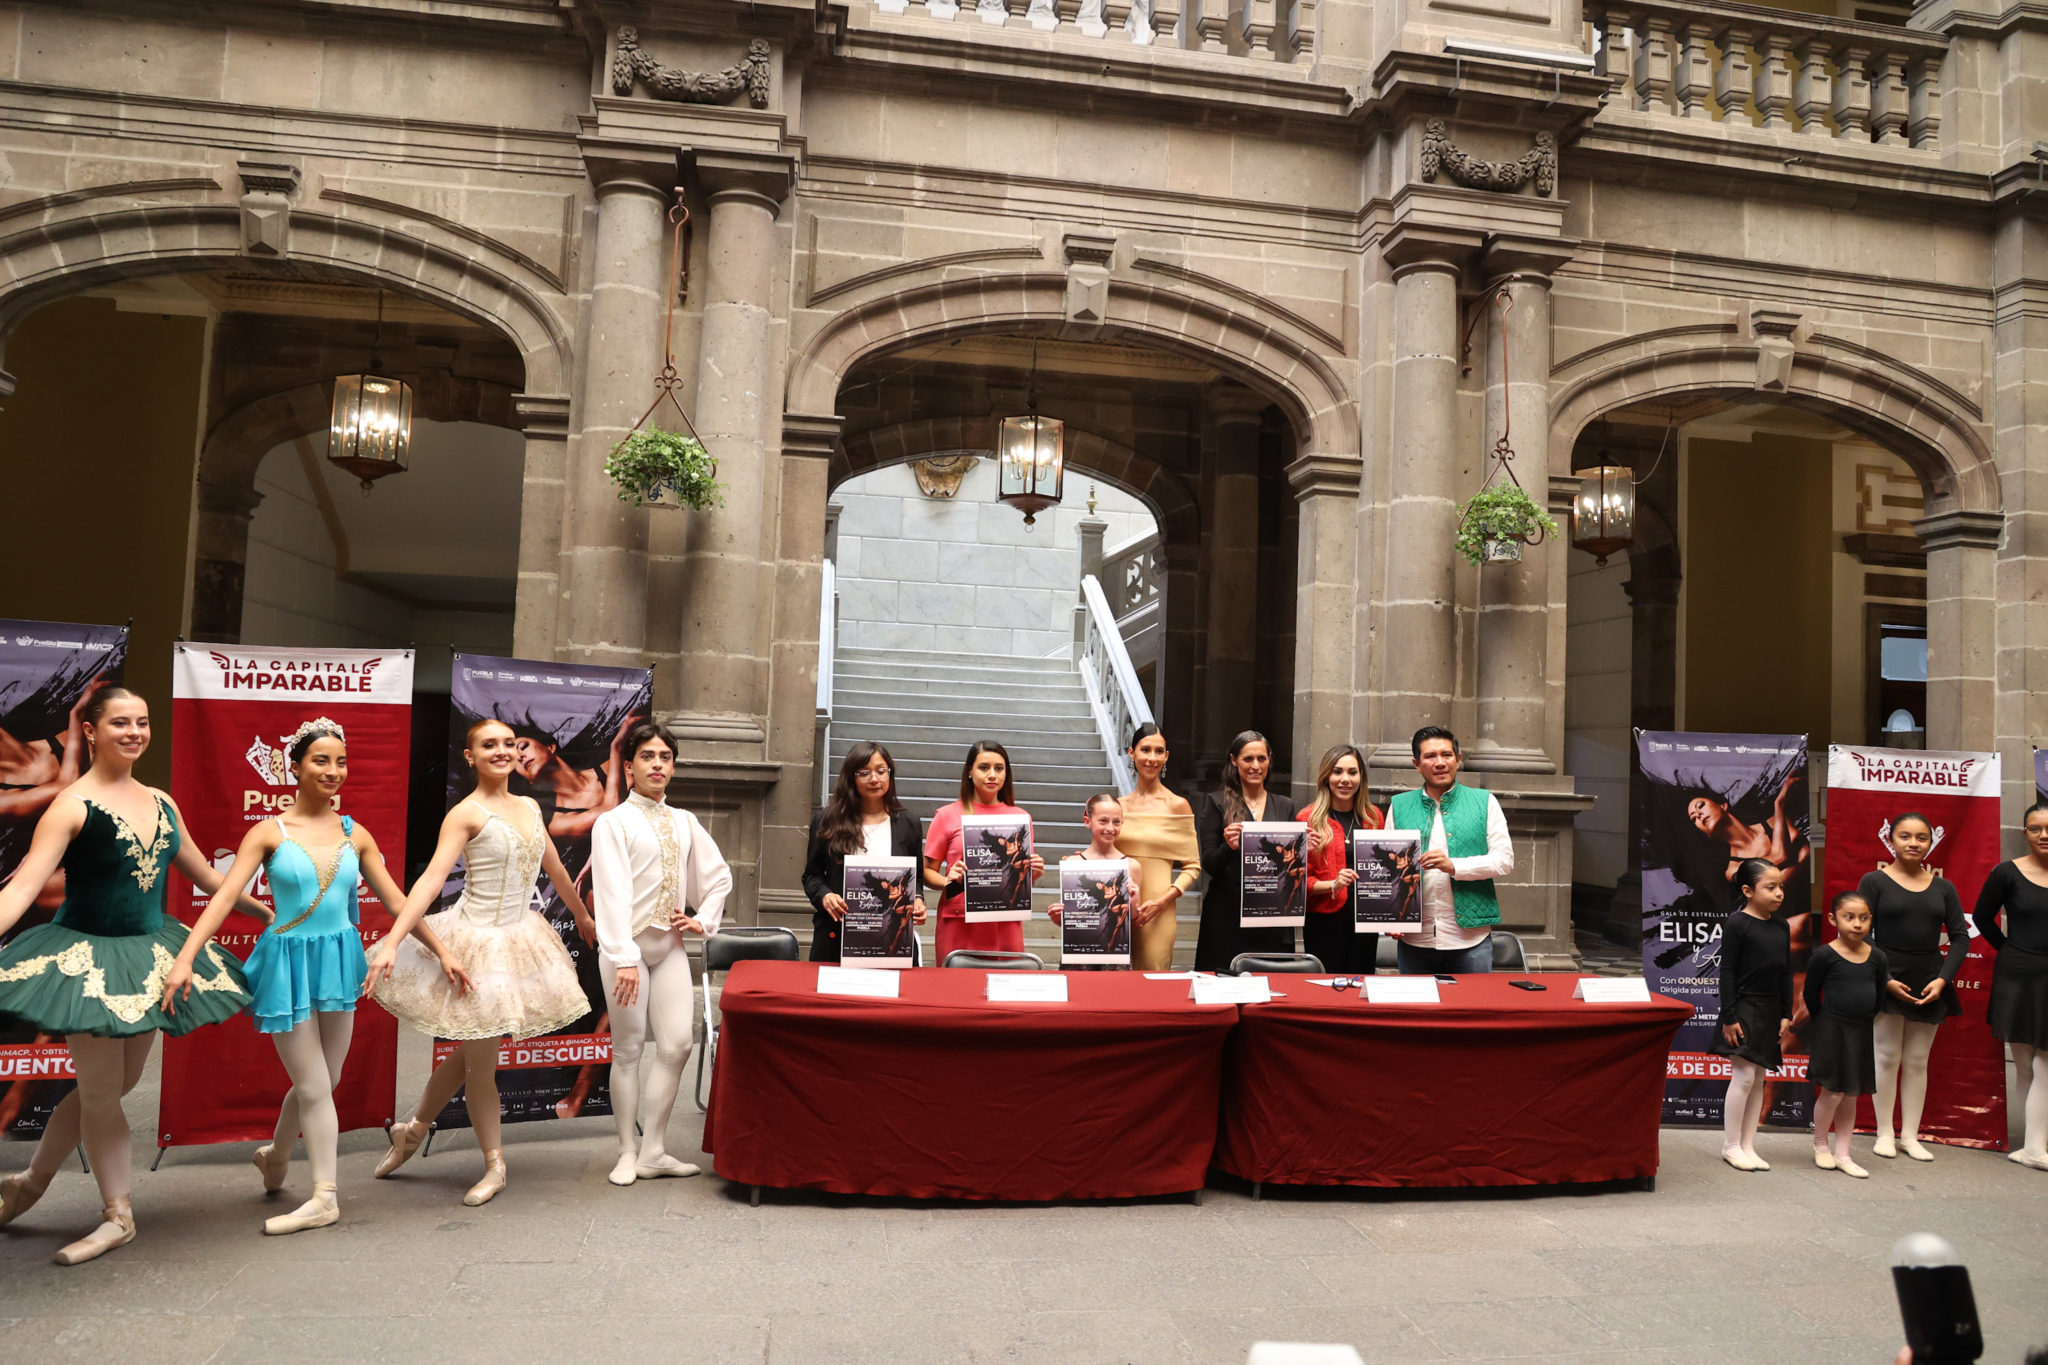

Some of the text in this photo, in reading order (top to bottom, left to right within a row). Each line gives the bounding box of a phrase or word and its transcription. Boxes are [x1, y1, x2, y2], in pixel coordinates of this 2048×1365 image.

[235, 659, 359, 674] LA CAPITAL
[224, 672, 372, 693] IMPARABLE
[1868, 758, 1960, 771] LA CAPITAL
[1861, 768, 1968, 787] IMPARABLE
[244, 790, 340, 812] Puea
[967, 848, 991, 857] ELISA
[1245, 856, 1269, 864] ELISA
[1358, 862, 1382, 871] ELISA
[847, 891, 873, 900] ELISA
[1064, 892, 1089, 901] ELISA
[1660, 921, 1723, 943] ELISA
[1660, 976, 1721, 987] Con ORQUEST
[1660, 986, 1689, 995] Dirigida
[42, 1048, 70, 1056] OBTEN
[436, 1046, 454, 1054] SUBE
[498, 1051, 510, 1065] E
[1682, 1062, 1705, 1075] DE
